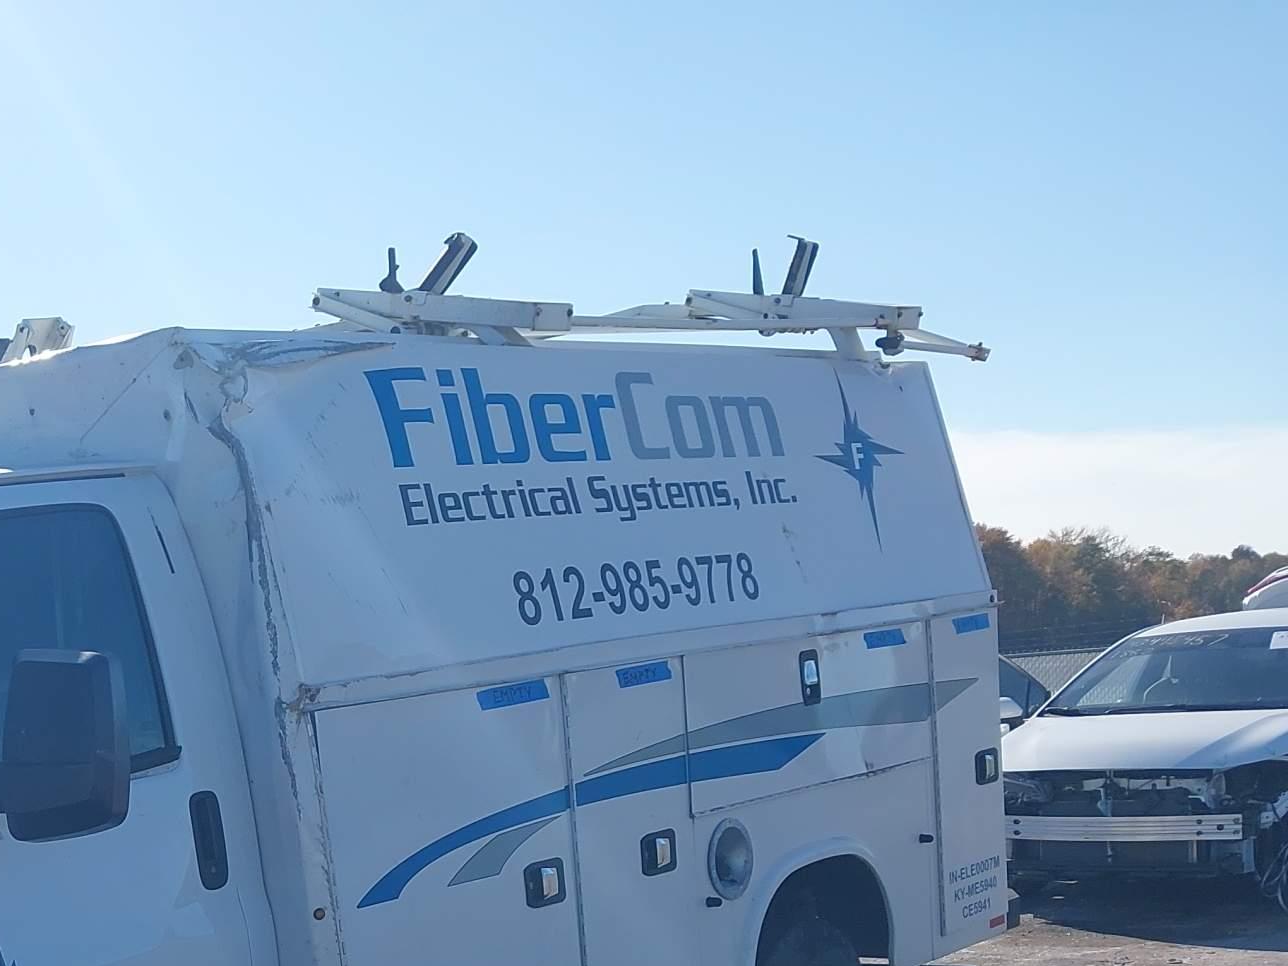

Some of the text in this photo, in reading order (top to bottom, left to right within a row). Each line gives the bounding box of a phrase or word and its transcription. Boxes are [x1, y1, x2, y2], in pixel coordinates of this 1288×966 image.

[363, 367, 785, 468] FiberCom
[850, 442, 865, 470] F
[399, 470, 798, 526] Electrical Systems, Inc.
[512, 552, 760, 626] 812-985-9778
[621, 666, 658, 686] EMPTY
[492, 685, 533, 703] EMPTY
[961, 897, 991, 919] CE5941
